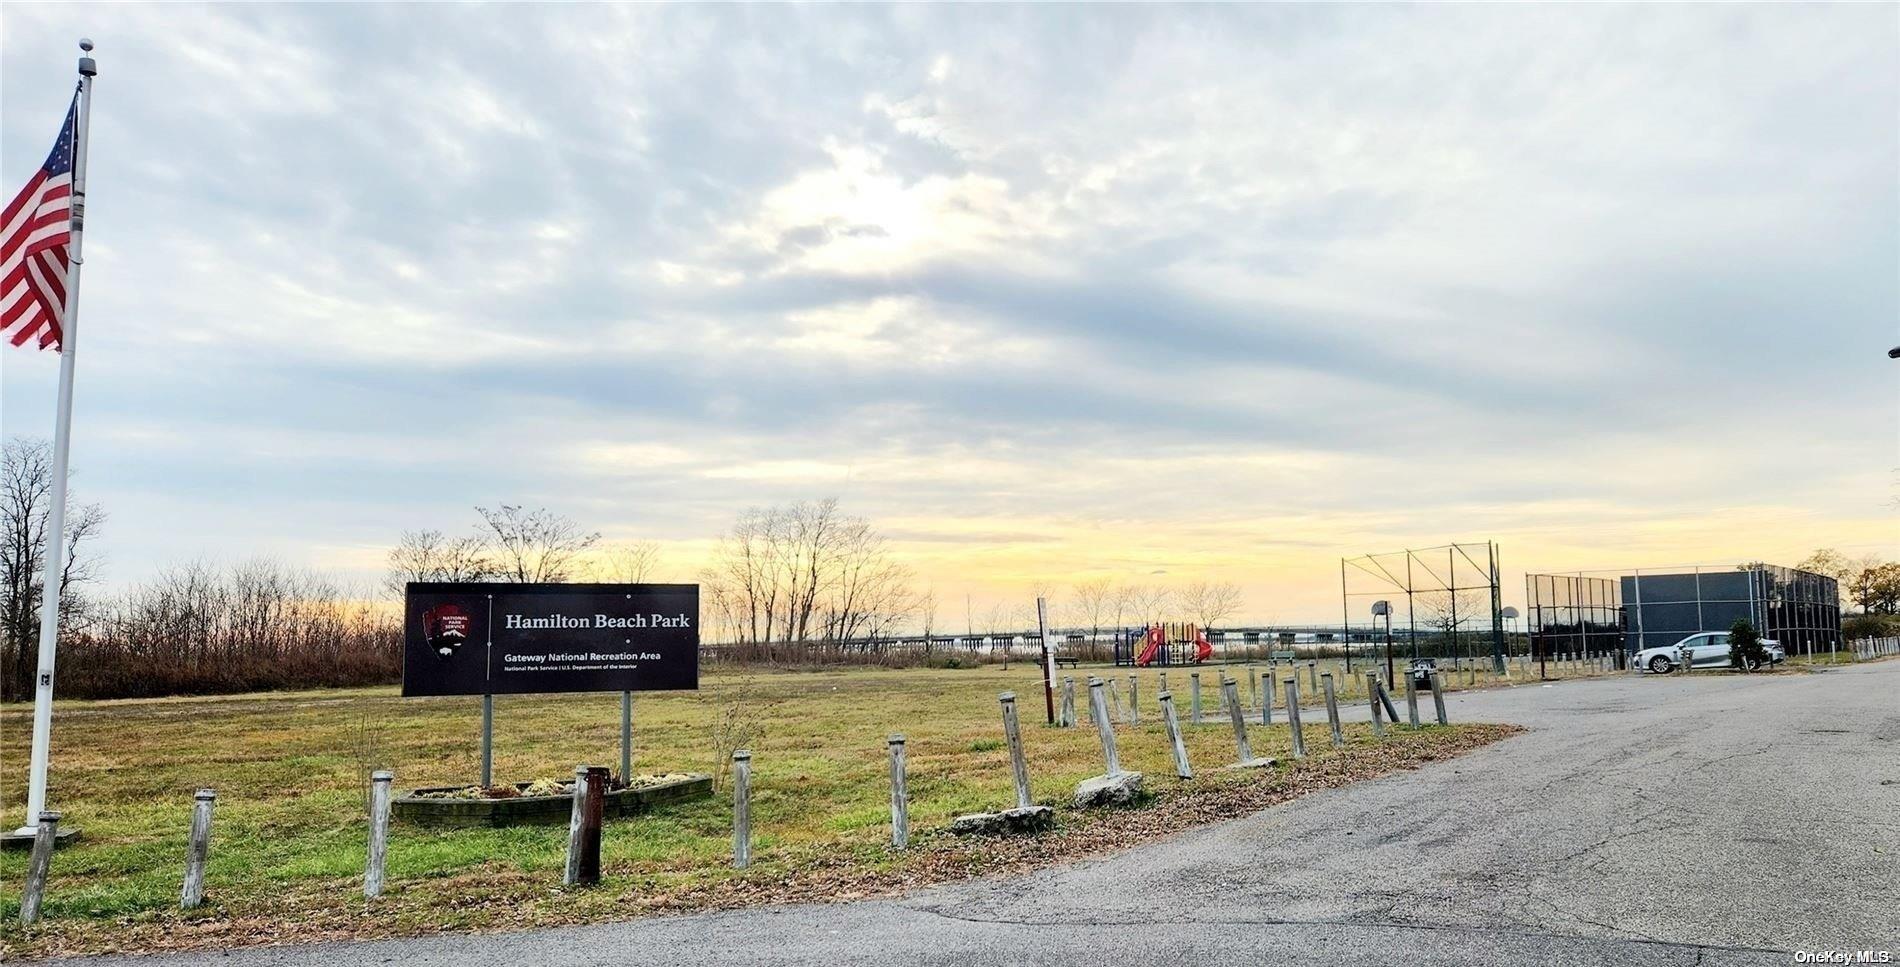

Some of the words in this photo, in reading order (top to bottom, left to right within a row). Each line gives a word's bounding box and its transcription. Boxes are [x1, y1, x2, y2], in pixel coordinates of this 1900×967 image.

[505, 614, 590, 629] Hamilton
[595, 613, 647, 629] Beach
[650, 613, 690, 628] Park
[504, 653, 546, 664] Gateway
[548, 652, 588, 662] National
[590, 651, 638, 661] Recreation
[639, 651, 661, 661] Area
